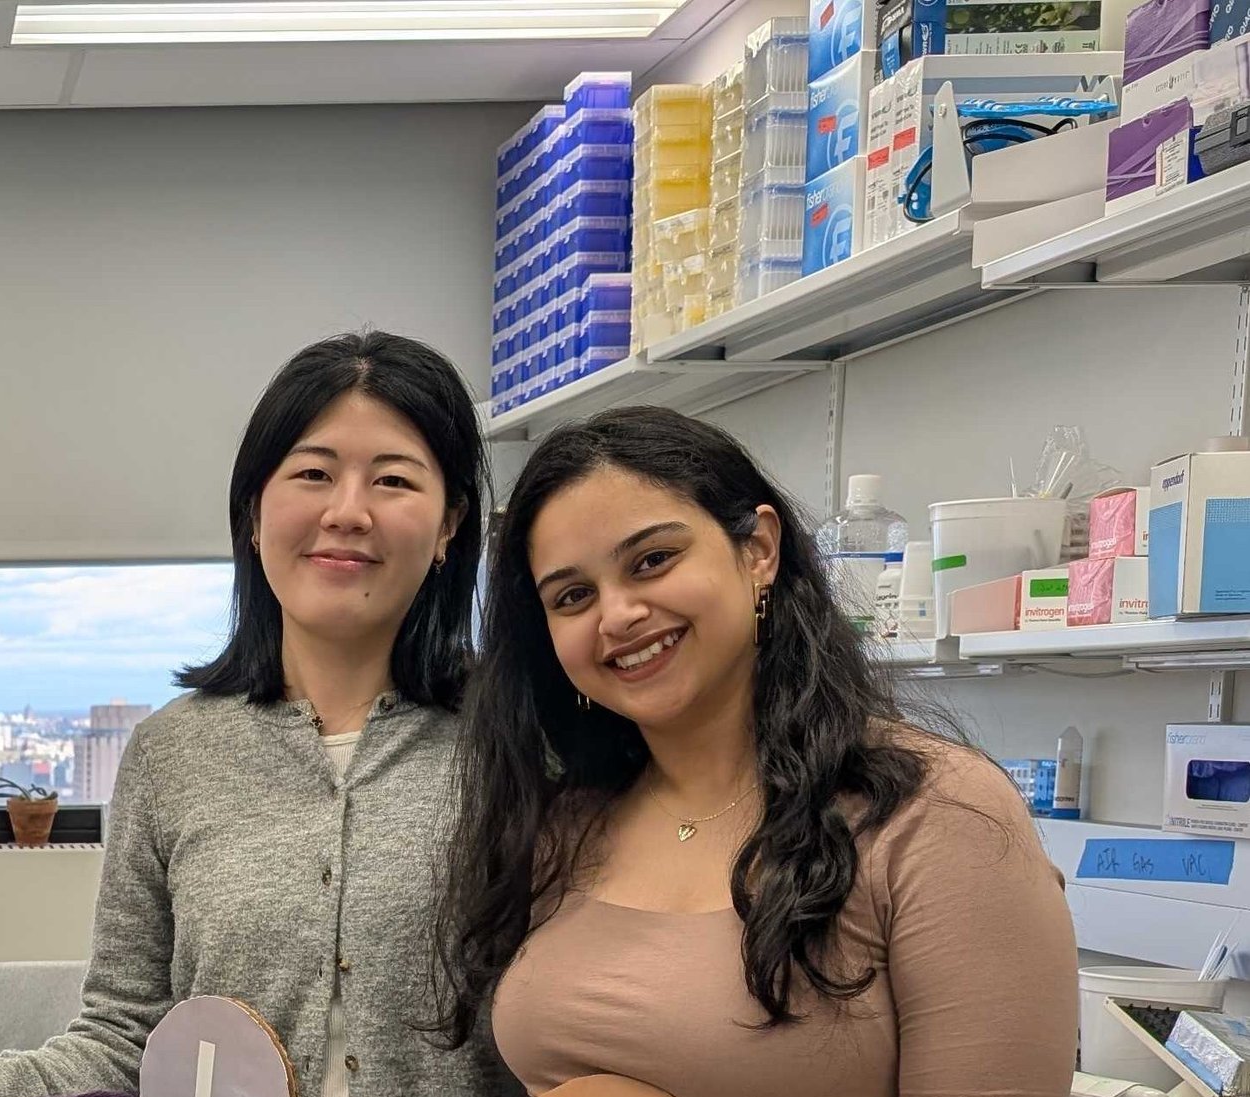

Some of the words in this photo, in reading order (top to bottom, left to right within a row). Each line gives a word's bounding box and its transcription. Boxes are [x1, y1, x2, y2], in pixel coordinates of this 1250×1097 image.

[1162, 470, 1184, 491] eppendorf
[1025, 607, 1065, 618] invitrogen
[1132, 852, 1154, 875] GAS
